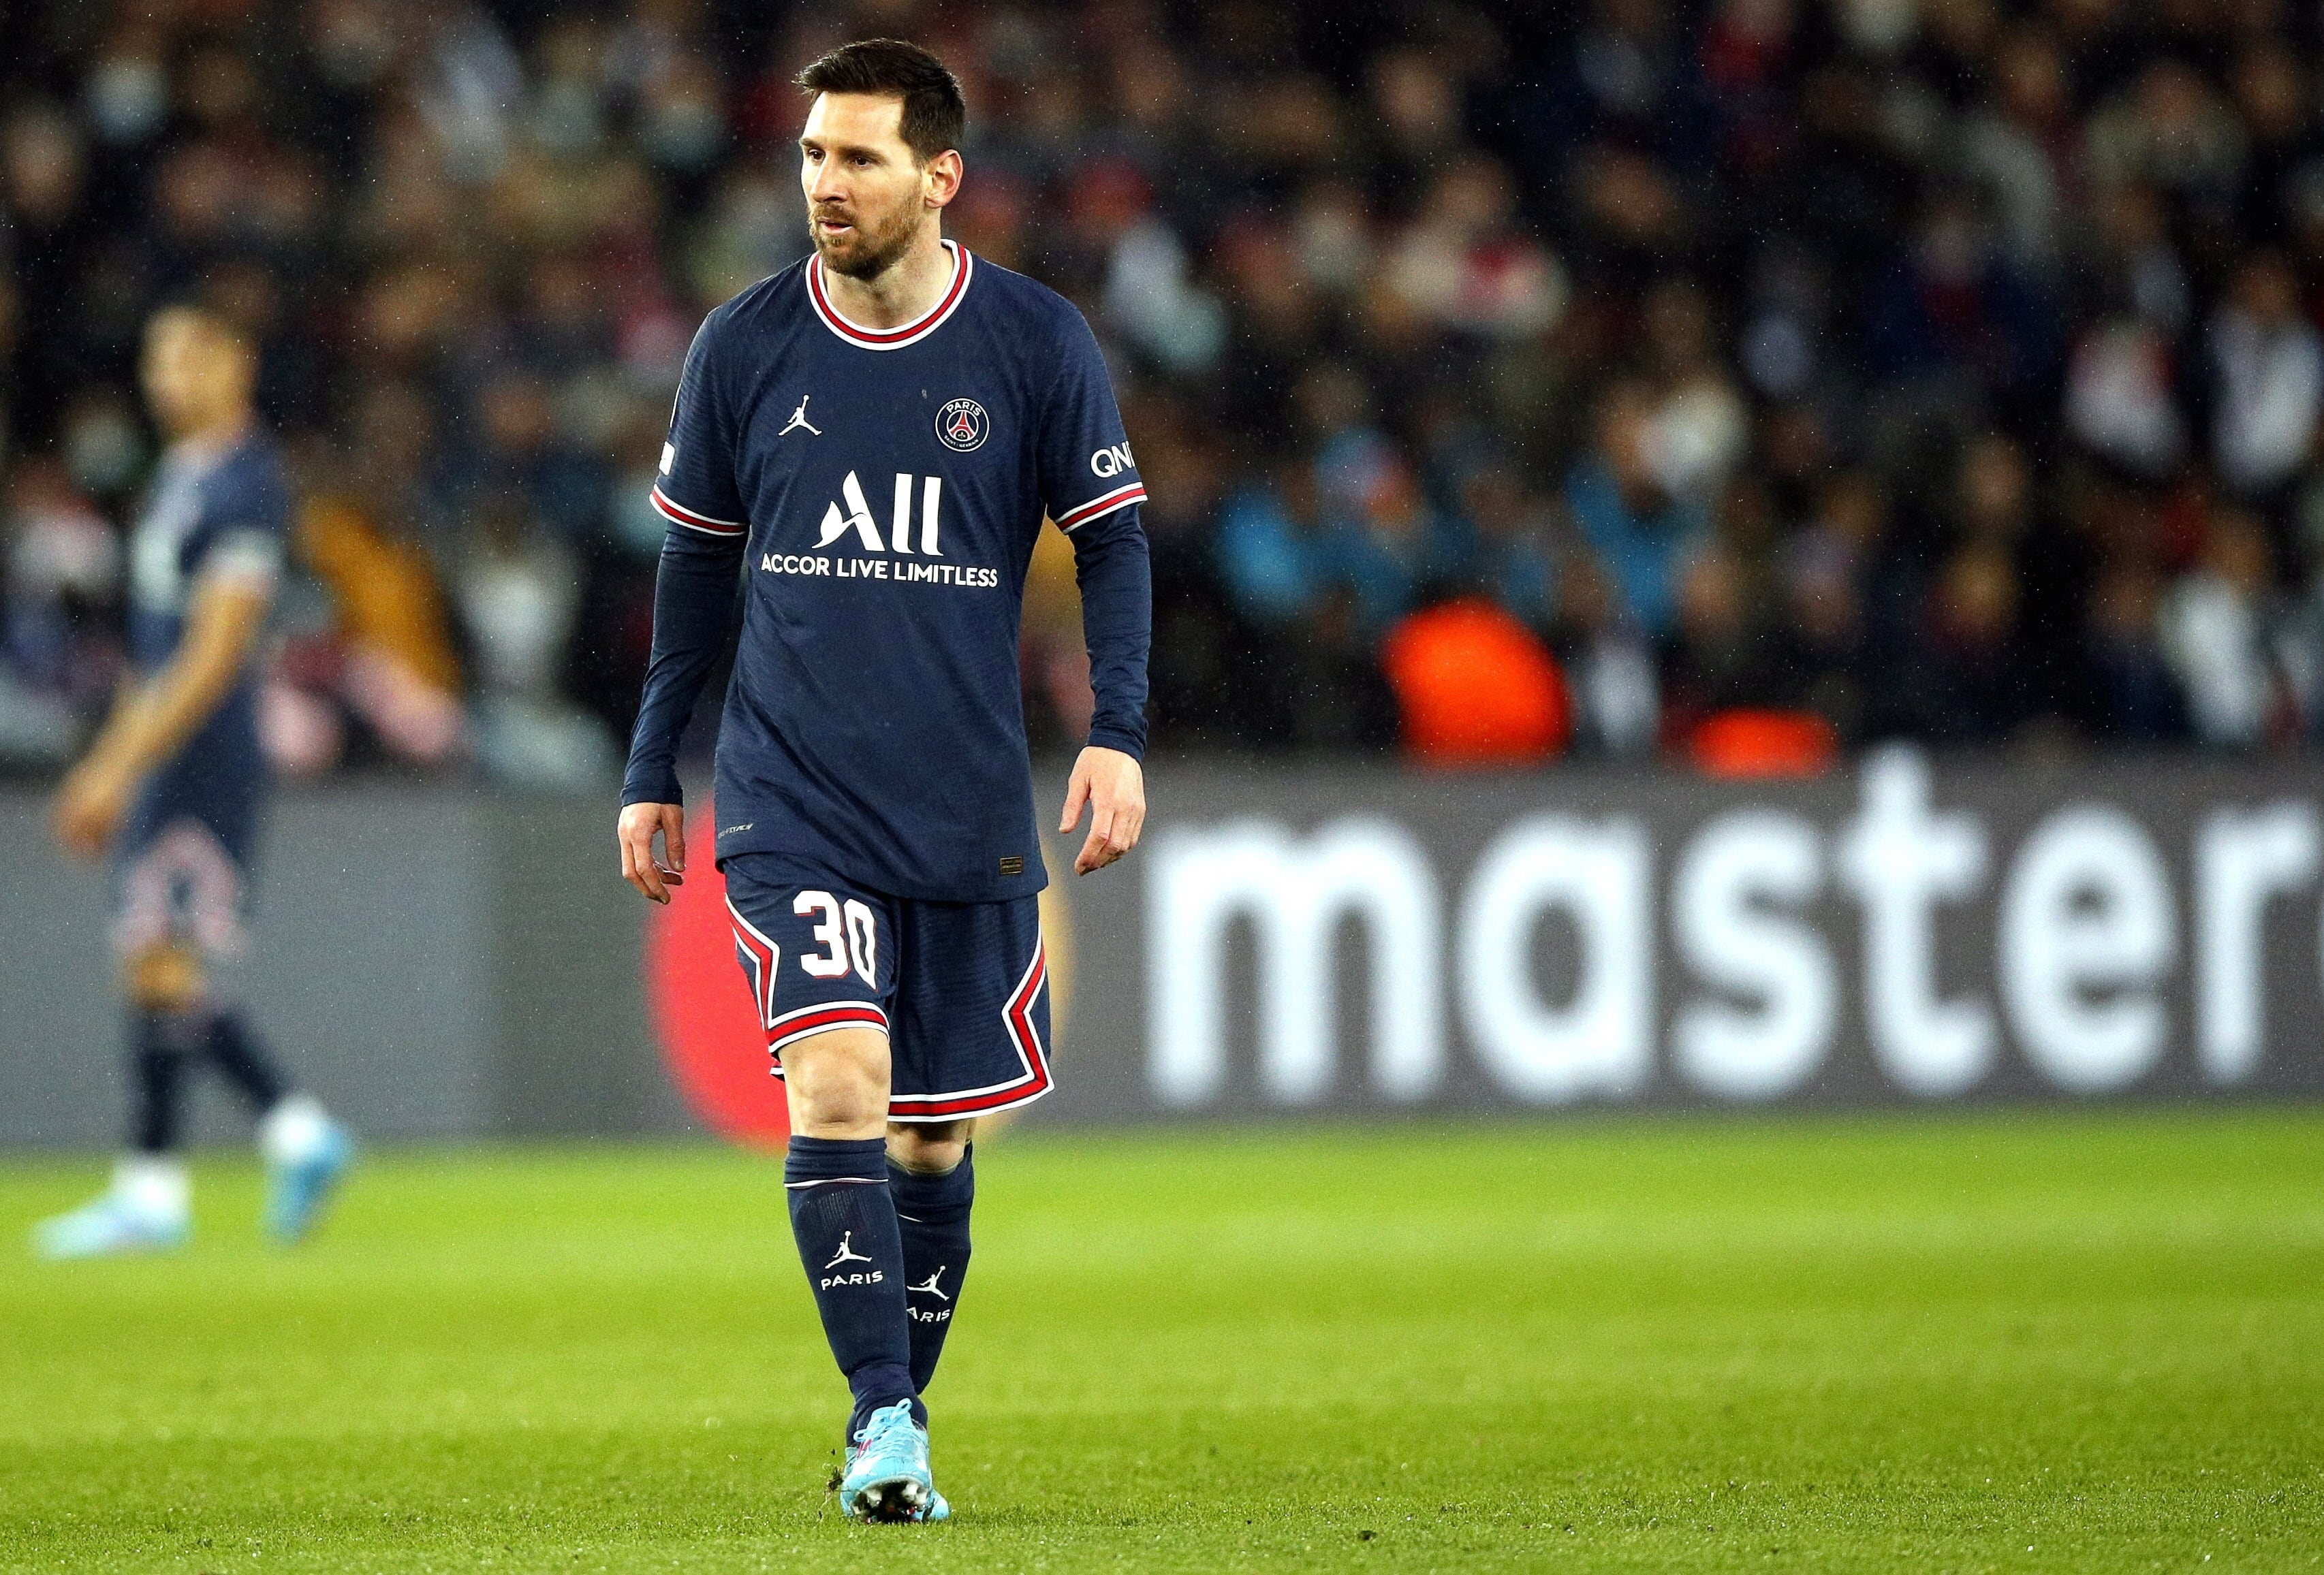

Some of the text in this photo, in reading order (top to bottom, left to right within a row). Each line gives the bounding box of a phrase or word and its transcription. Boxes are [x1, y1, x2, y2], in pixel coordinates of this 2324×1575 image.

[946, 401, 982, 416] PARIS
[1090, 441, 1135, 478] QN
[761, 552, 998, 588] ACCOR LIVE LIMITLESS
[792, 889, 879, 992] 30
[1146, 741, 2324, 1104] master
[821, 1269, 883, 1291] PARIS
[906, 1306, 951, 1322] ARIS
